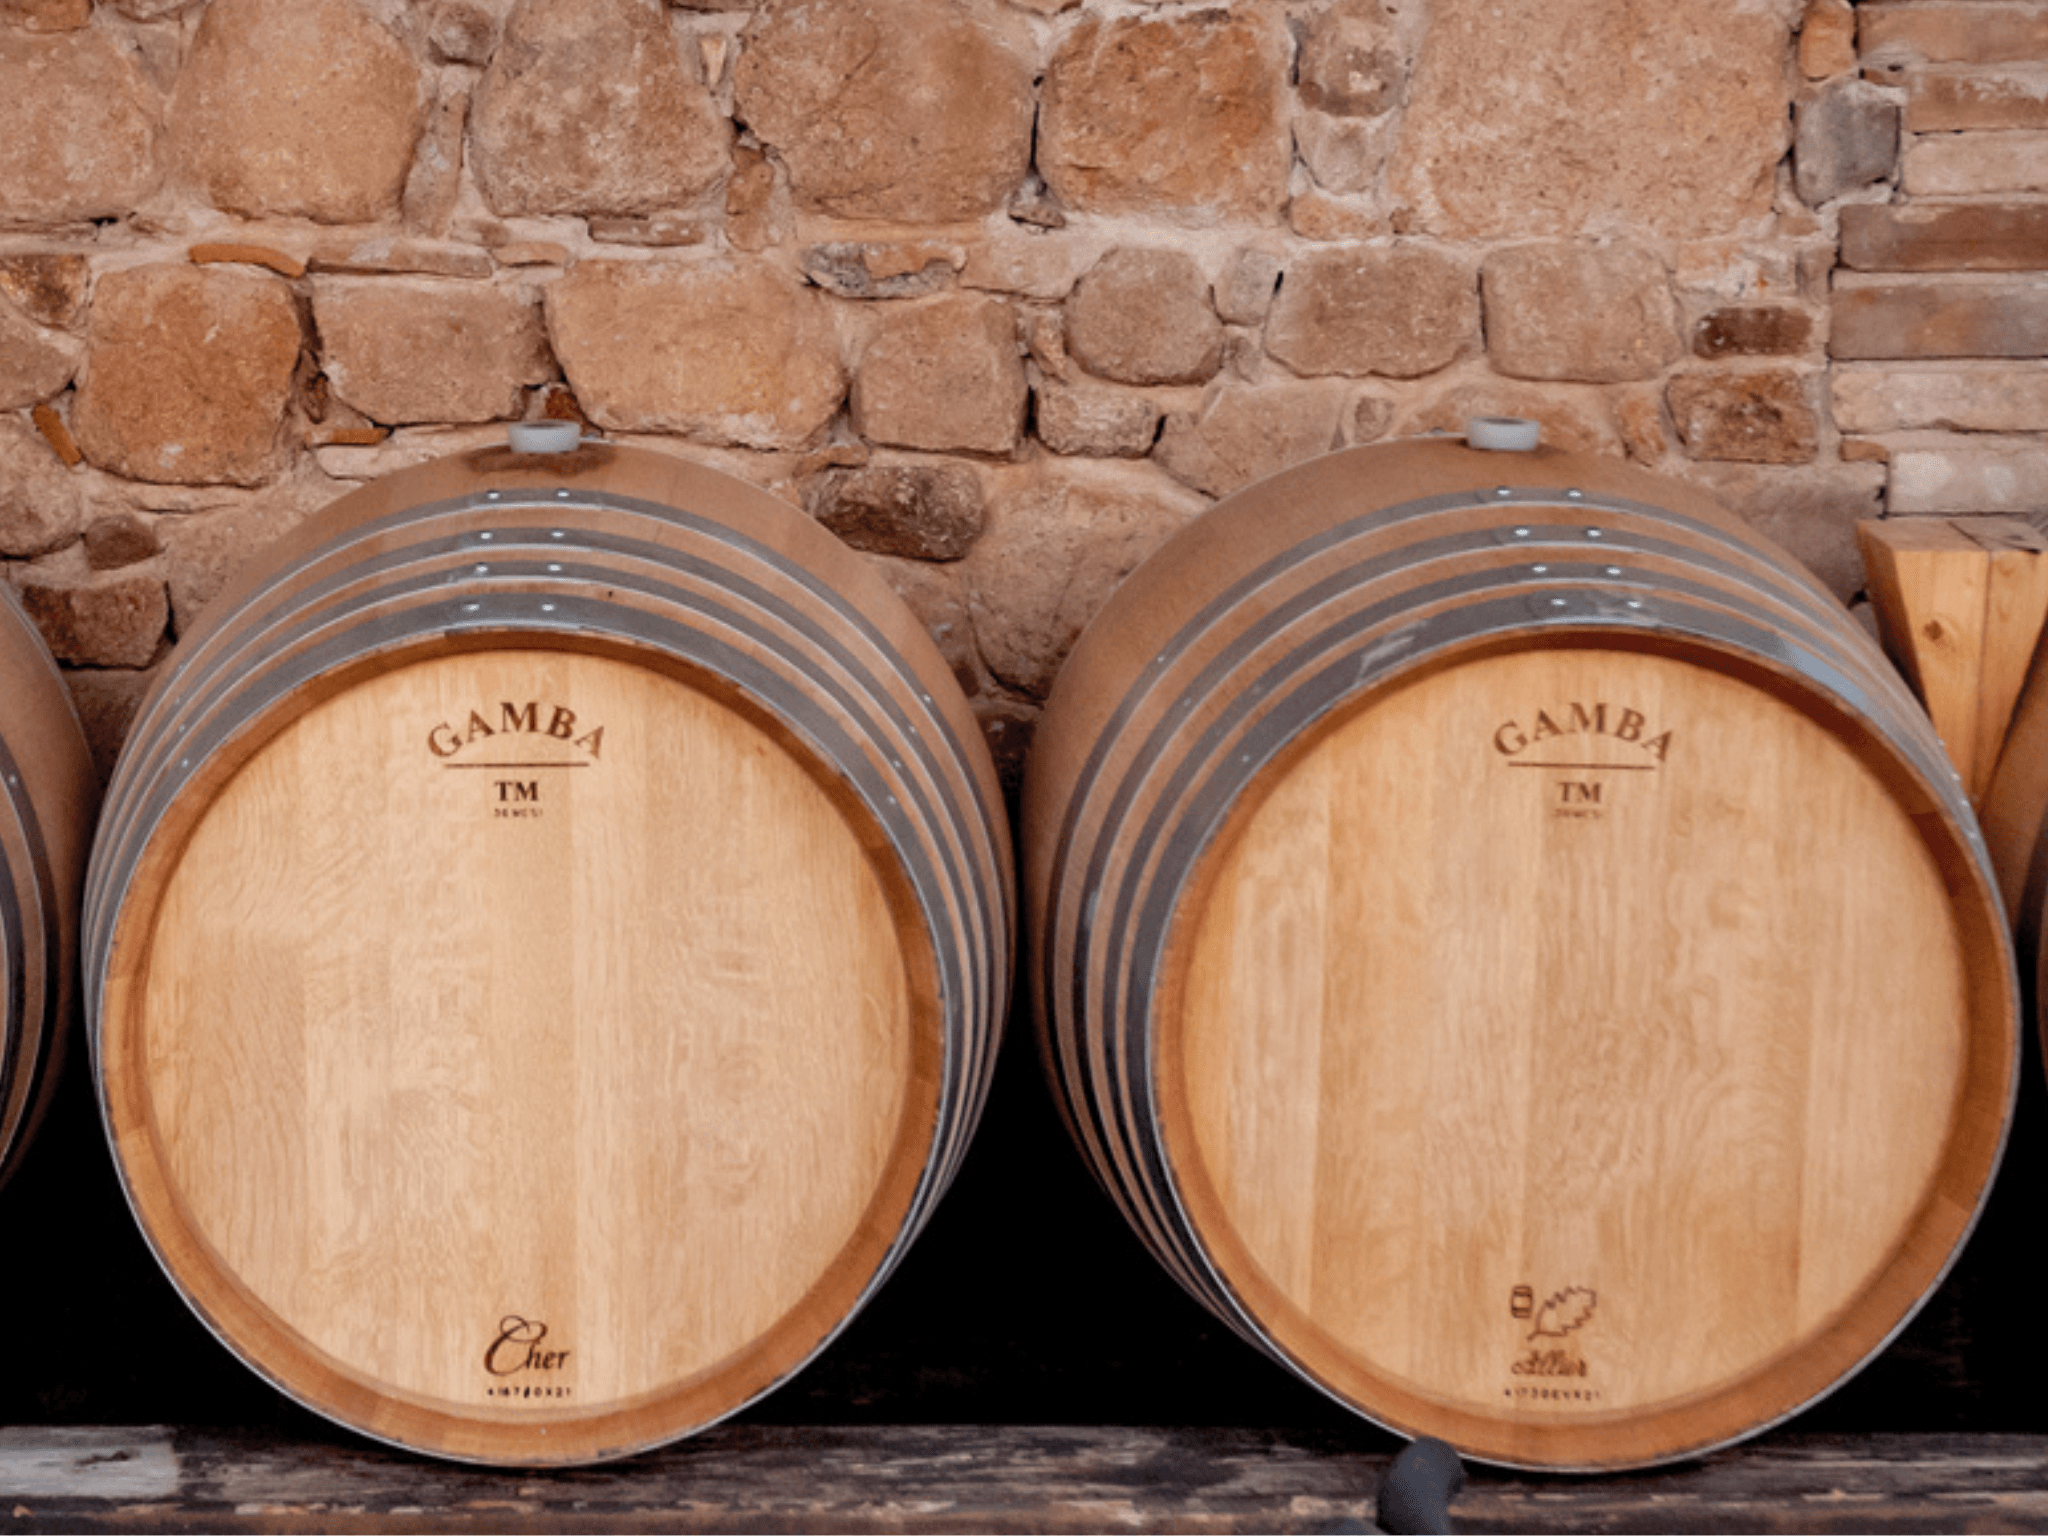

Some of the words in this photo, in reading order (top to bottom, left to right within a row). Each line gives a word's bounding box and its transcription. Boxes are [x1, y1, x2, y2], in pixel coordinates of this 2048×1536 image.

[427, 701, 604, 759] GAMBA
[1493, 702, 1672, 763] GAMBA
[494, 781, 539, 802] TM
[1558, 781, 1602, 803] TM
[484, 1315, 571, 1377] Cher
